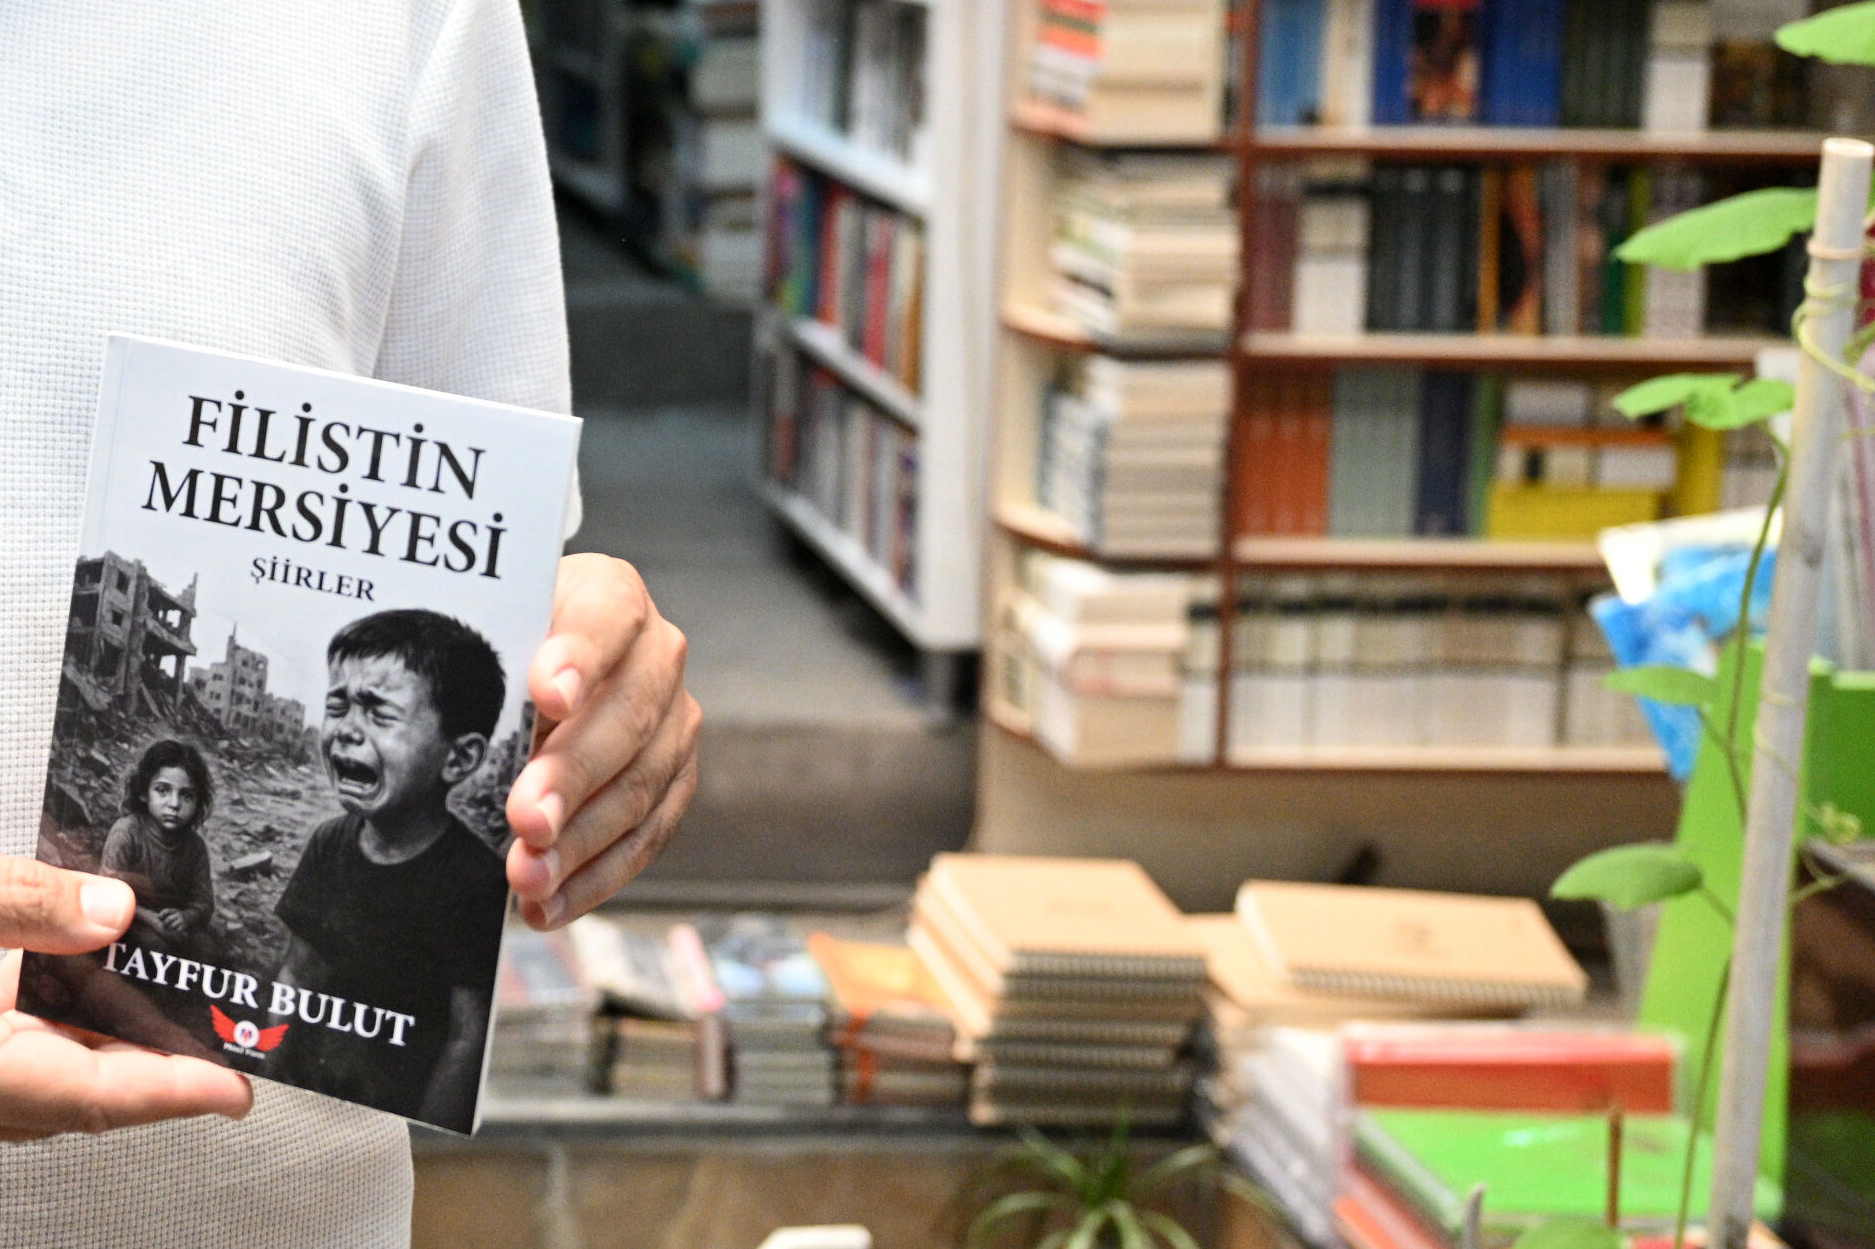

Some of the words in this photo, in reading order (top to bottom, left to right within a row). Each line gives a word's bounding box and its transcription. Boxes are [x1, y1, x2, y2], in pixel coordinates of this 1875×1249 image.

[182, 390, 486, 500] FİLİSTİN
[141, 460, 507, 579] MERSİYESİ
[250, 555, 376, 602] ŞİİRLER
[103, 942, 259, 1010] TAYFUR
[267, 981, 416, 1047] BULUT
